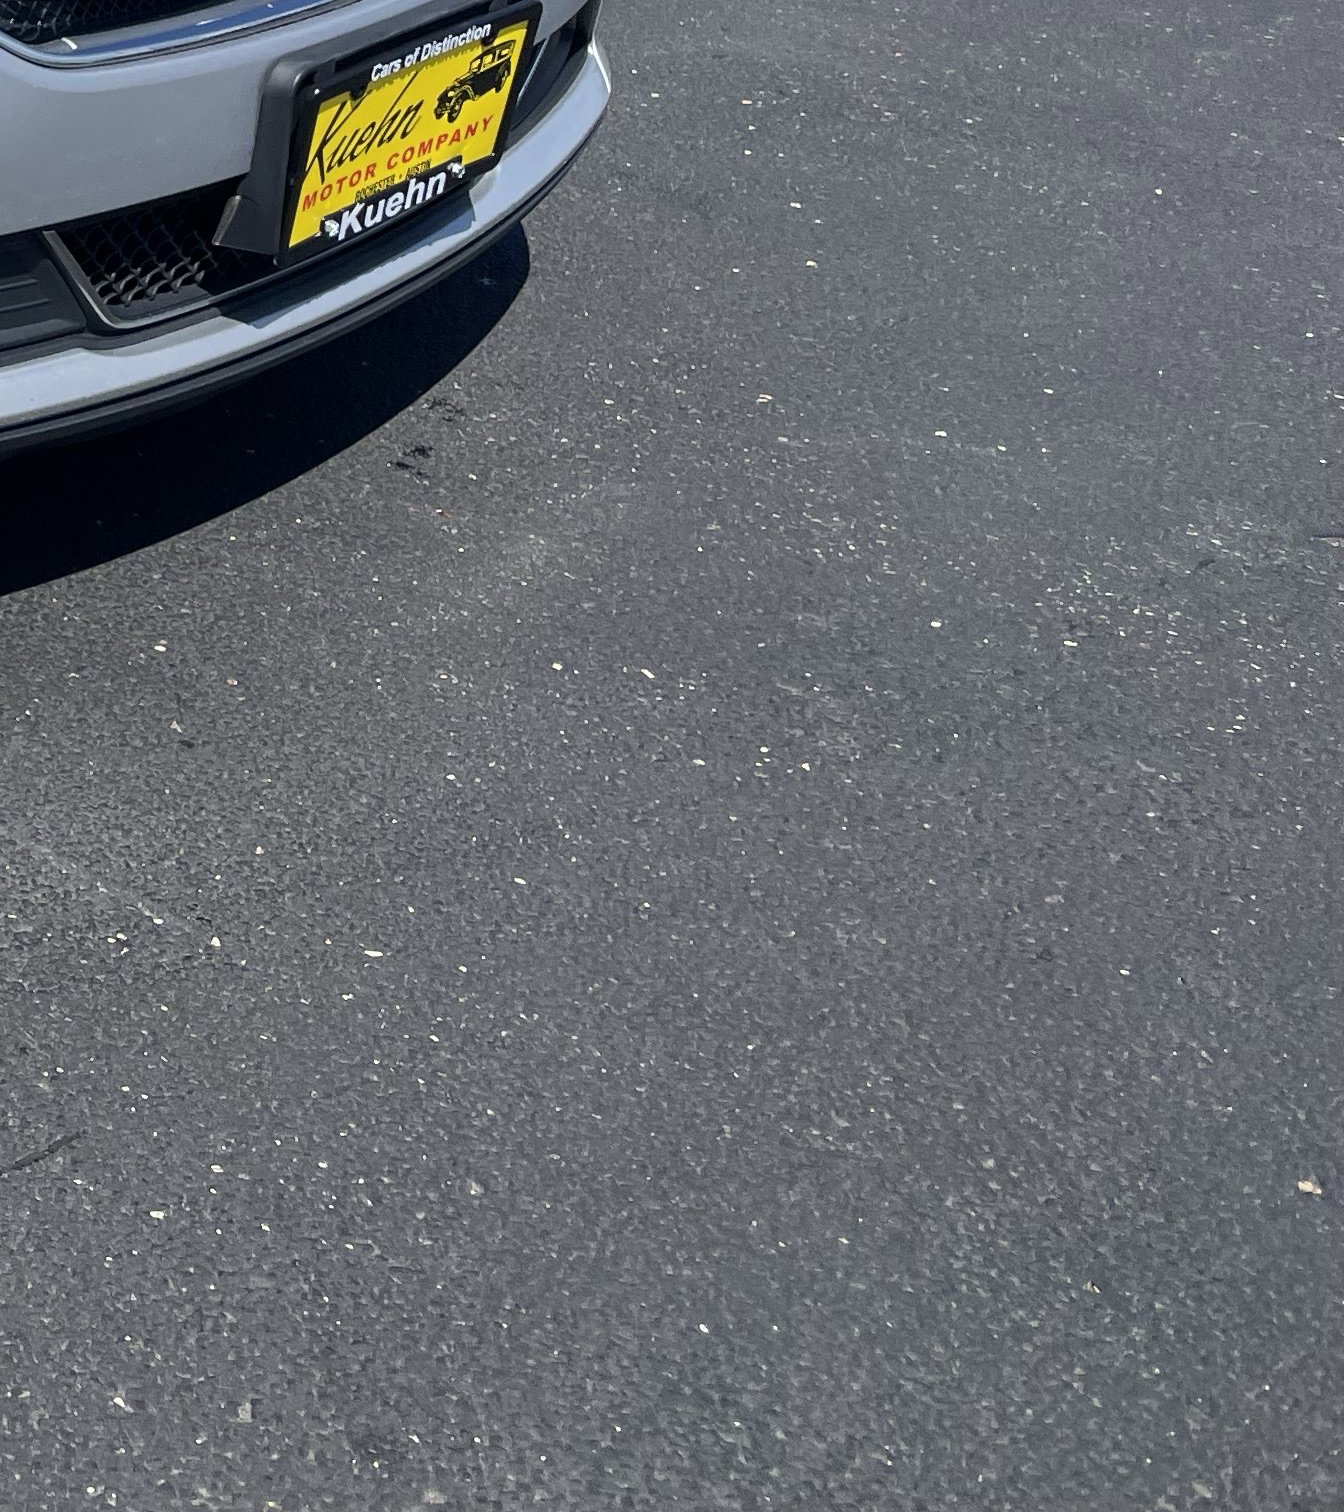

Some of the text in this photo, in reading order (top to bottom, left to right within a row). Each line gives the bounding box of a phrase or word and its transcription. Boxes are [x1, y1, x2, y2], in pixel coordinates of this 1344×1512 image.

[370, 23, 492, 82] Cars of Distinction
[301, 115, 495, 212] MOTOR COMPANY
[305, 71, 425, 185] Kuehn
[337, 170, 447, 241] Kuehn
